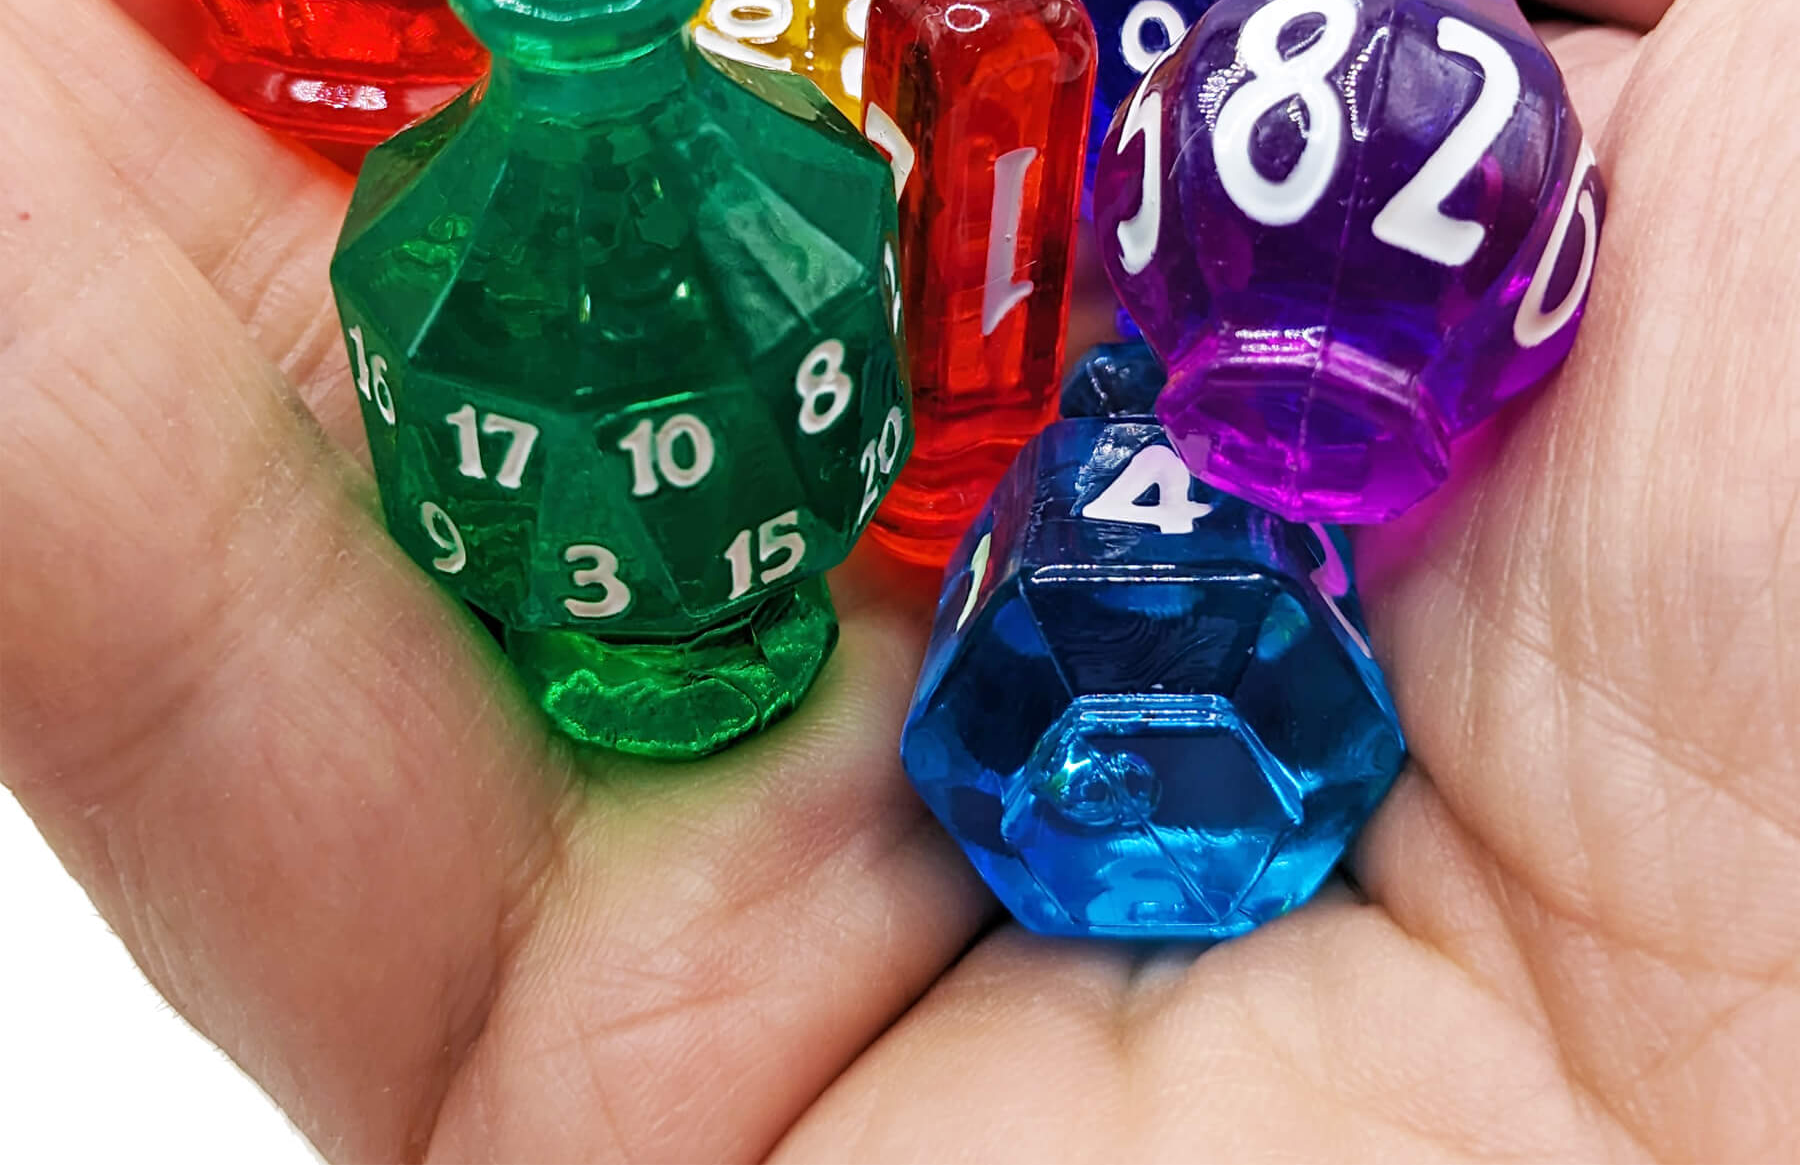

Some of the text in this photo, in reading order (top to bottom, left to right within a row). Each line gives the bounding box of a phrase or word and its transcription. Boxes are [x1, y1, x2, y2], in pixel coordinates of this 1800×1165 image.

[1371, 16, 1521, 267] 2
[1513, 136, 1600, 349] 0
[348, 325, 397, 426] 16
[795, 338, 853, 436] 8
[446, 404, 540, 490] 17
[619, 413, 716, 497] 10
[858, 406, 903, 526] 20
[1082, 444, 1214, 535] 4
[421, 501, 467, 575] 9
[564, 544, 632, 620] 3
[723, 509, 808, 601] 15
